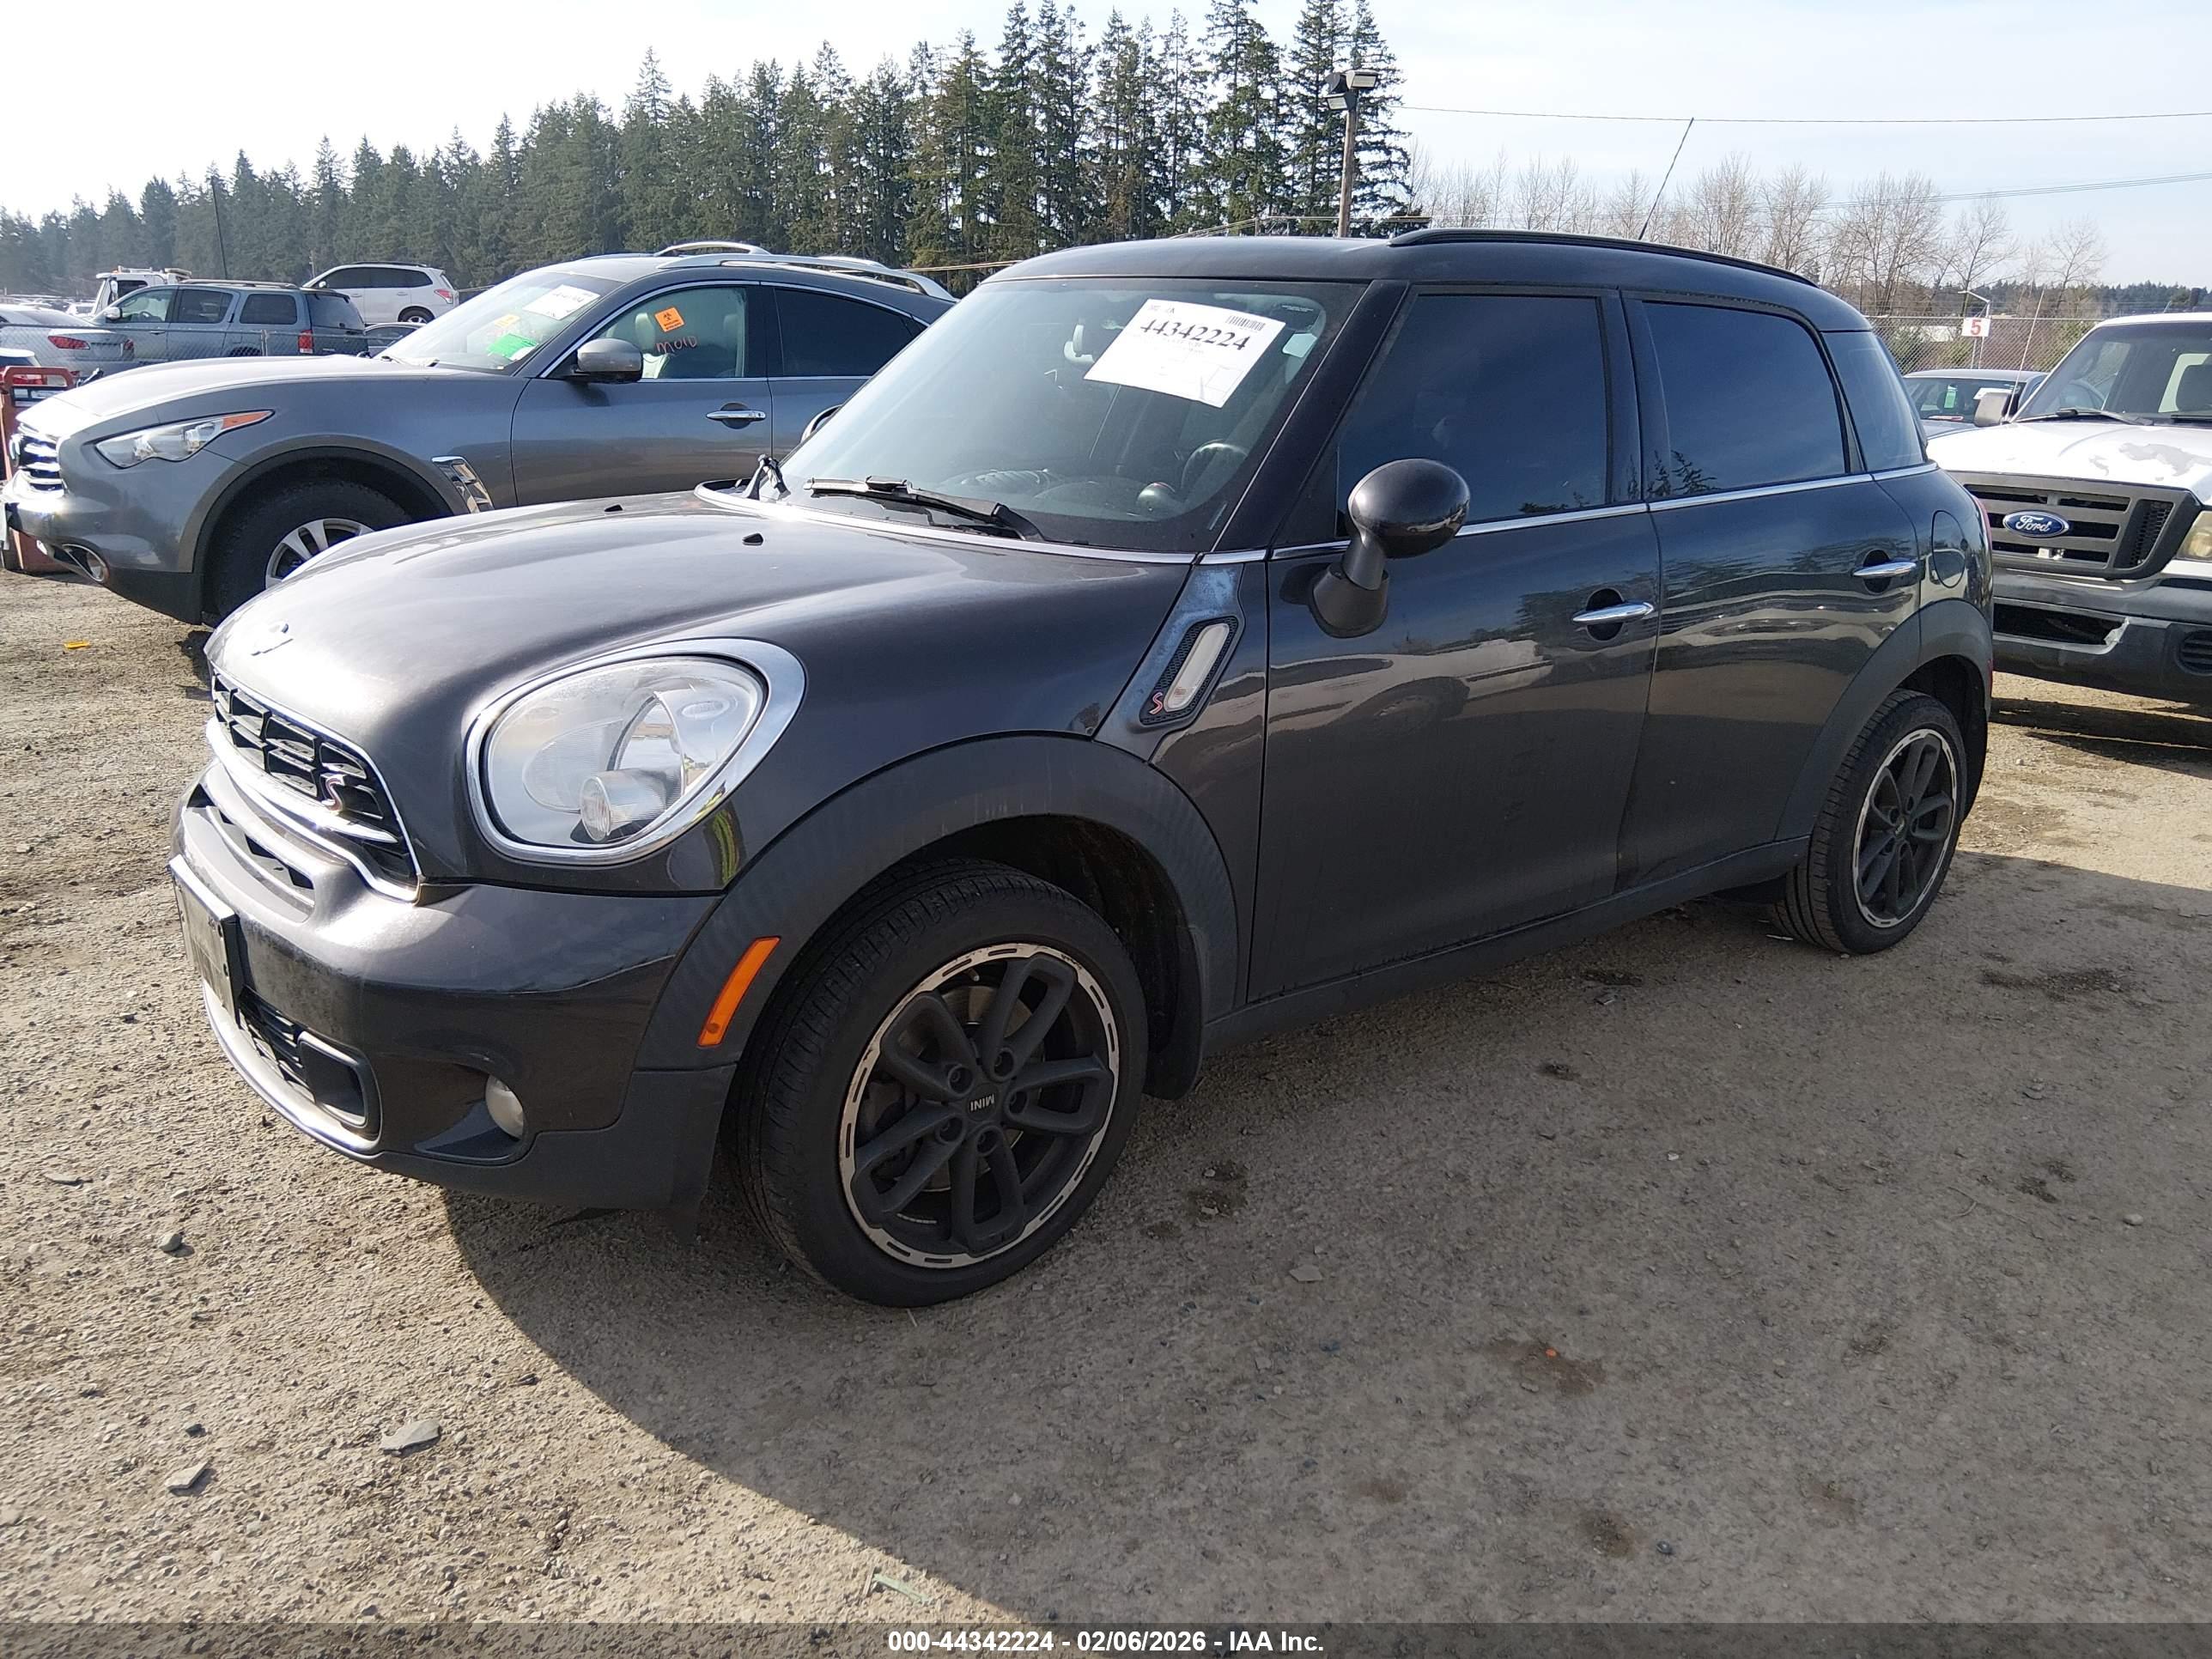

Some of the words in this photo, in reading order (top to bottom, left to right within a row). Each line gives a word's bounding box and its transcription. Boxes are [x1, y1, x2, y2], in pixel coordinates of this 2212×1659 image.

[1140, 319, 1250, 350] 44342224
[1971, 319, 1981, 336] 5
[2015, 515, 2052, 532] Ford
[1149, 692, 1163, 714] S
[322, 775, 345, 811] S
[970, 1094, 994, 1111] MINI
